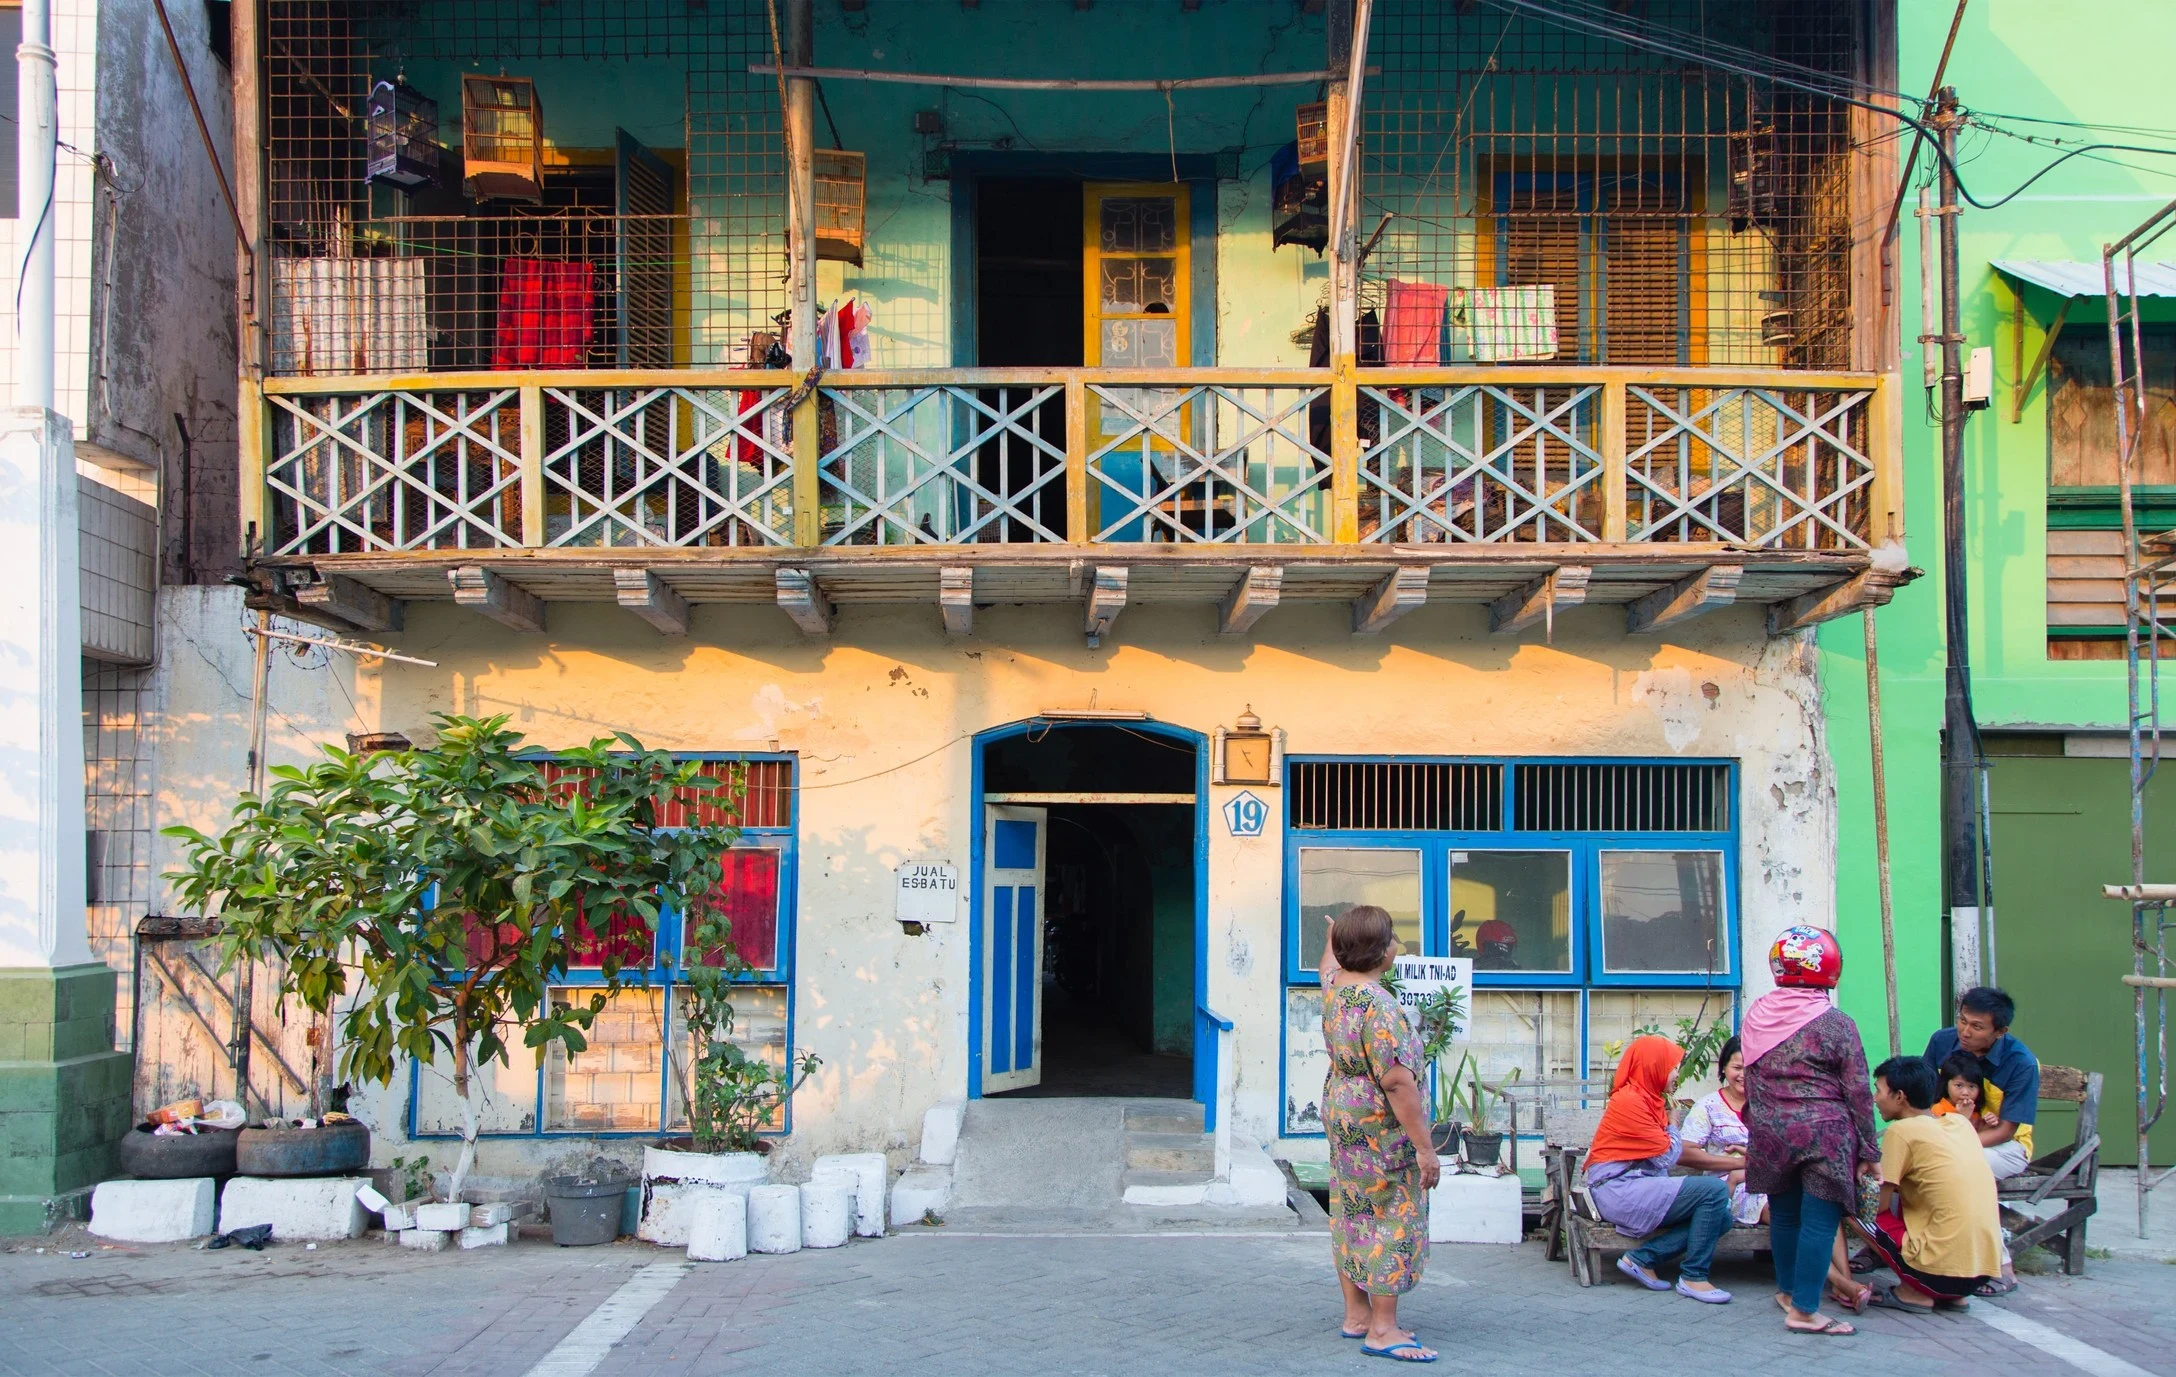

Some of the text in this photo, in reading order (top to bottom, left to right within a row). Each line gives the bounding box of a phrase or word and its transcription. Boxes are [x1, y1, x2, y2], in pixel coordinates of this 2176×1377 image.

[1232, 799, 1263, 832] 19
[912, 866, 947, 877] JUAL
[1404, 963, 1427, 980] MILIK
[1429, 965, 1457, 981] TNI-AD
